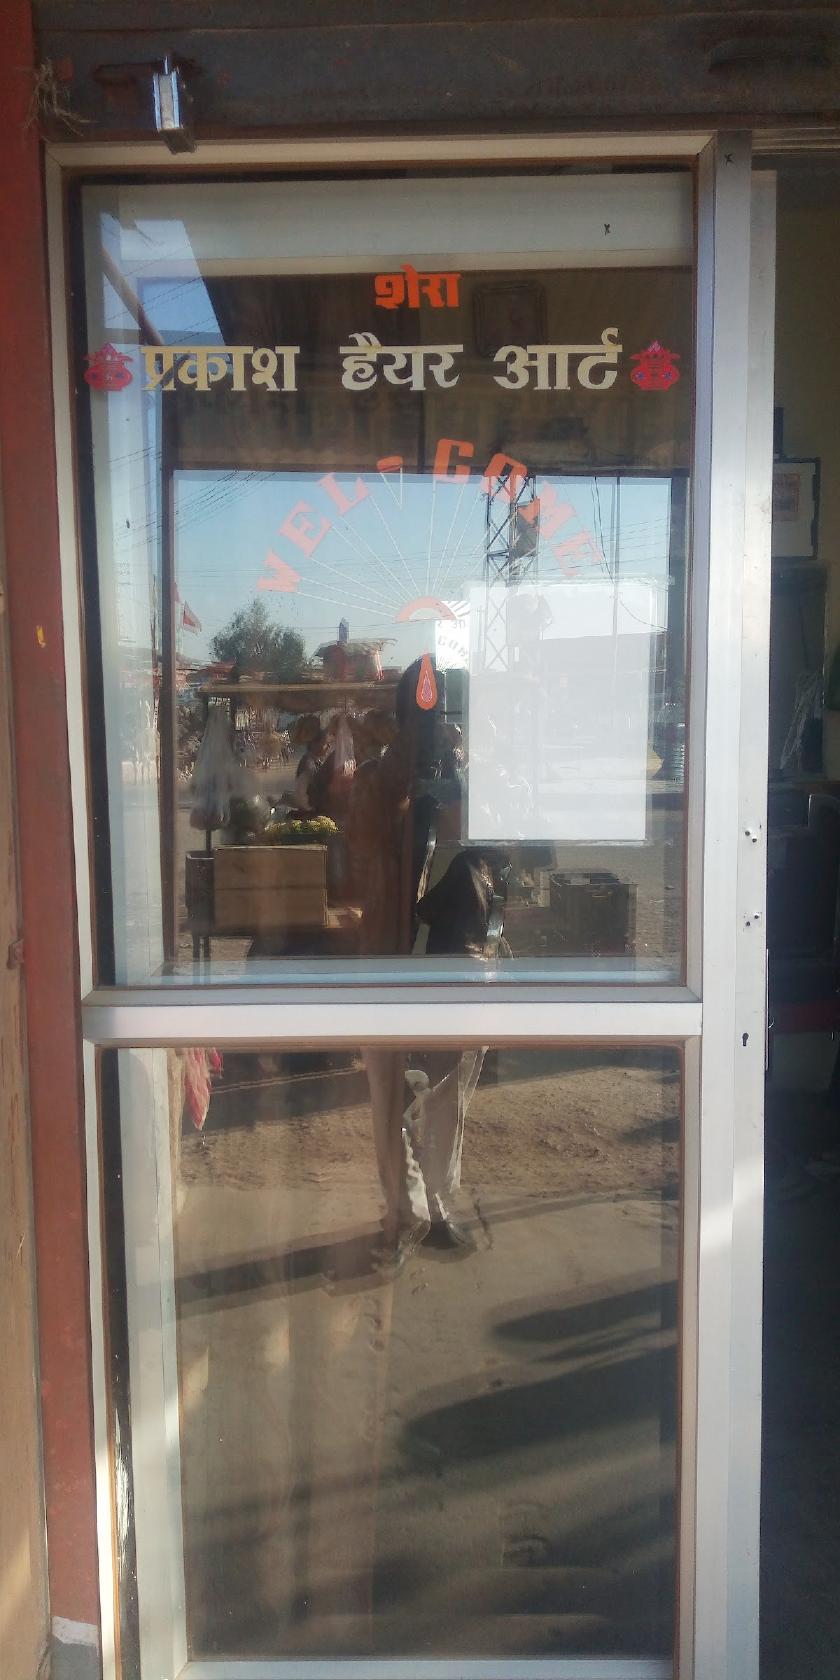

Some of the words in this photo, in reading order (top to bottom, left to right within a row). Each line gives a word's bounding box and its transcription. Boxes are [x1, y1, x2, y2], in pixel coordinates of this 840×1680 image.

[374, 263, 461, 310] शेरा
[141, 345, 301, 391] प्रकाश
[340, 331, 464, 391] हैयर
[493, 327, 623, 391] आर्ट
